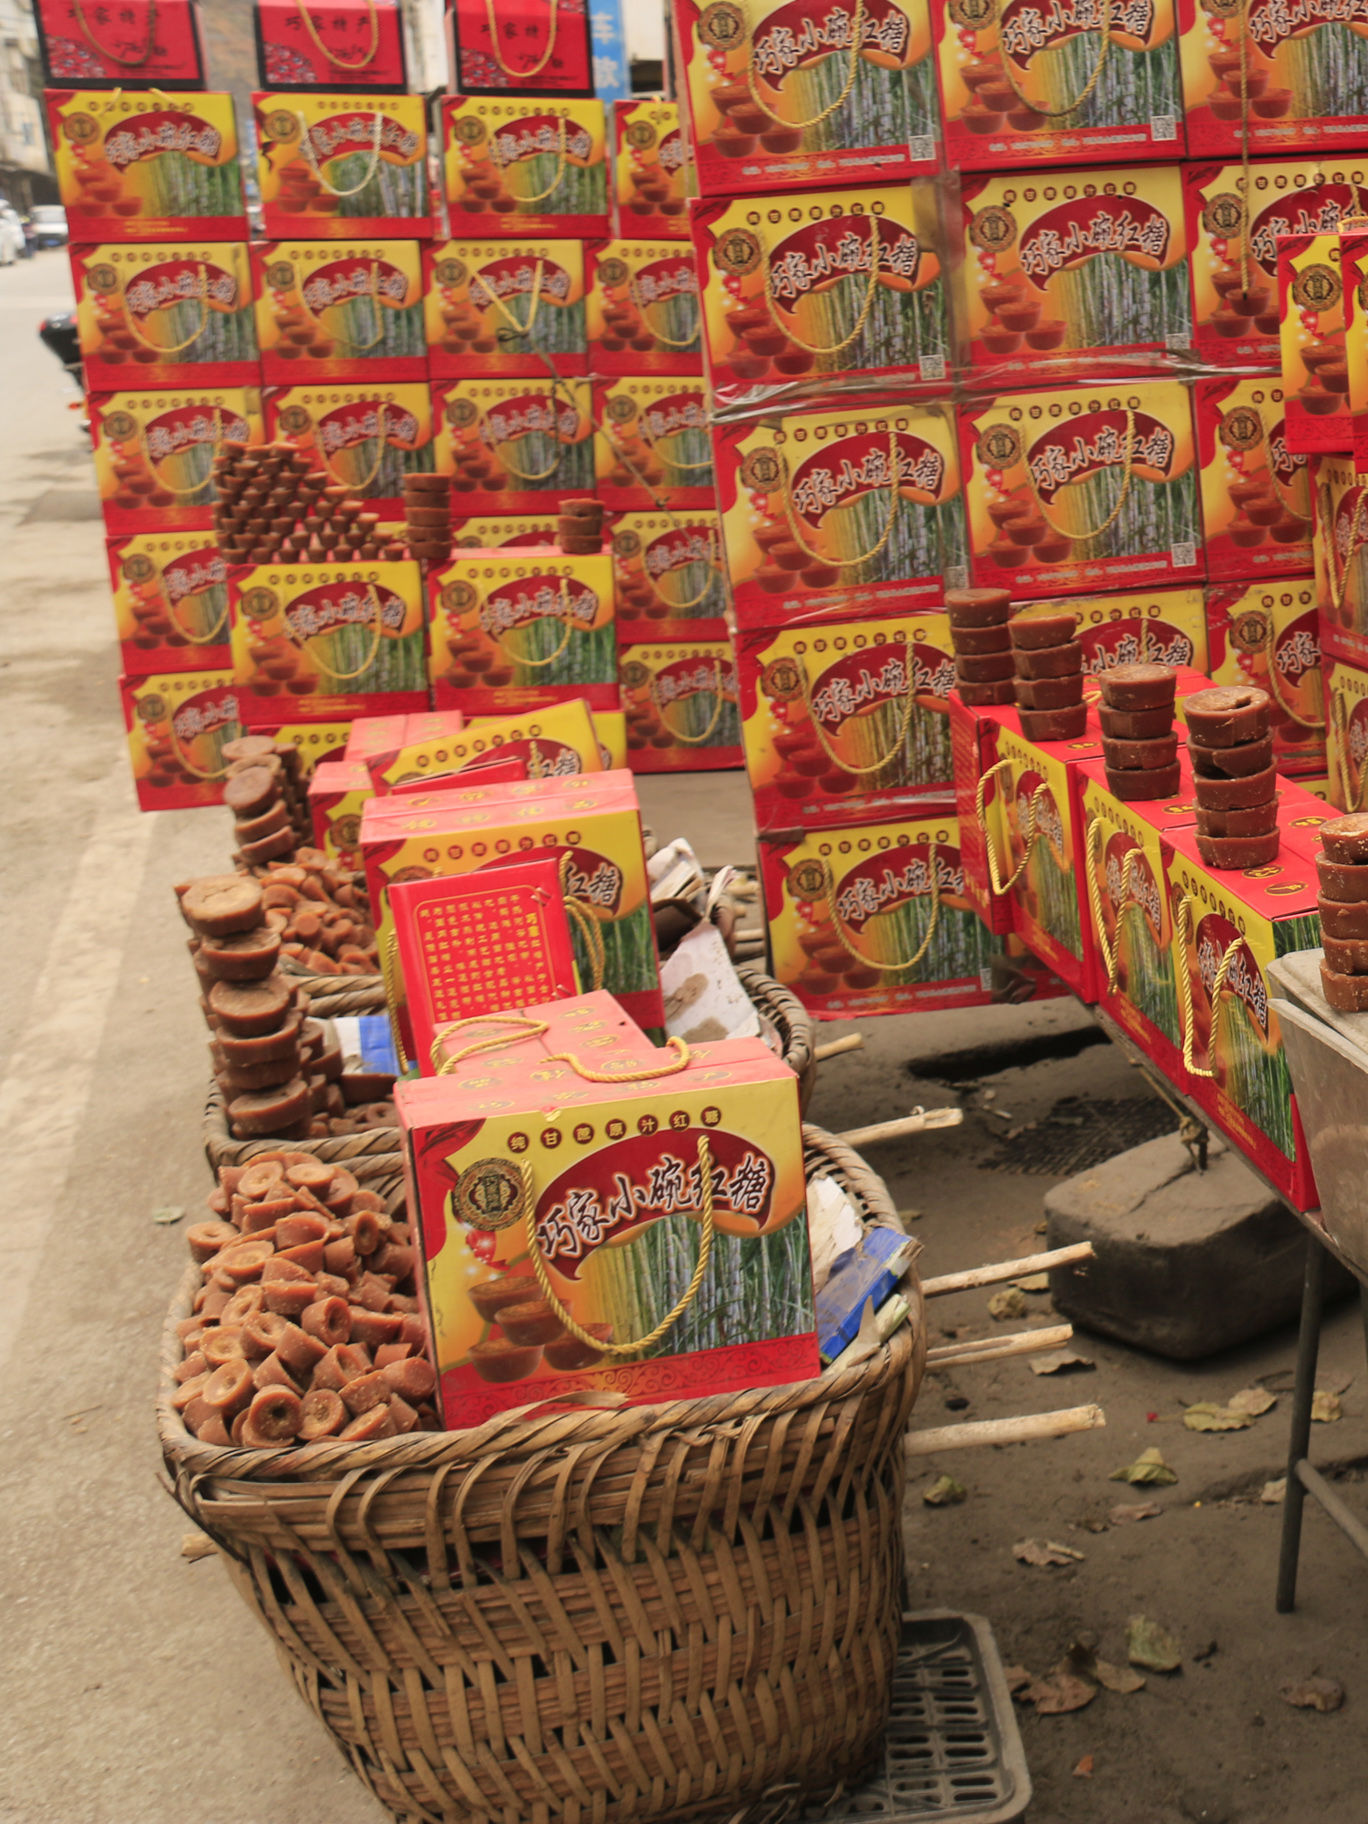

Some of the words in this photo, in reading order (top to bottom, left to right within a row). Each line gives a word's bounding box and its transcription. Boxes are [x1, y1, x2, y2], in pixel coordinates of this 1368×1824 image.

[1021, 211, 1168, 275] 巧家小碗红糖
[1030, 425, 1174, 489] 巧家小碗红糖
[508, 1106, 722, 1154] 纯甘蔗原汁红糖
[536, 1150, 772, 1260] 巧家小碗红糖
